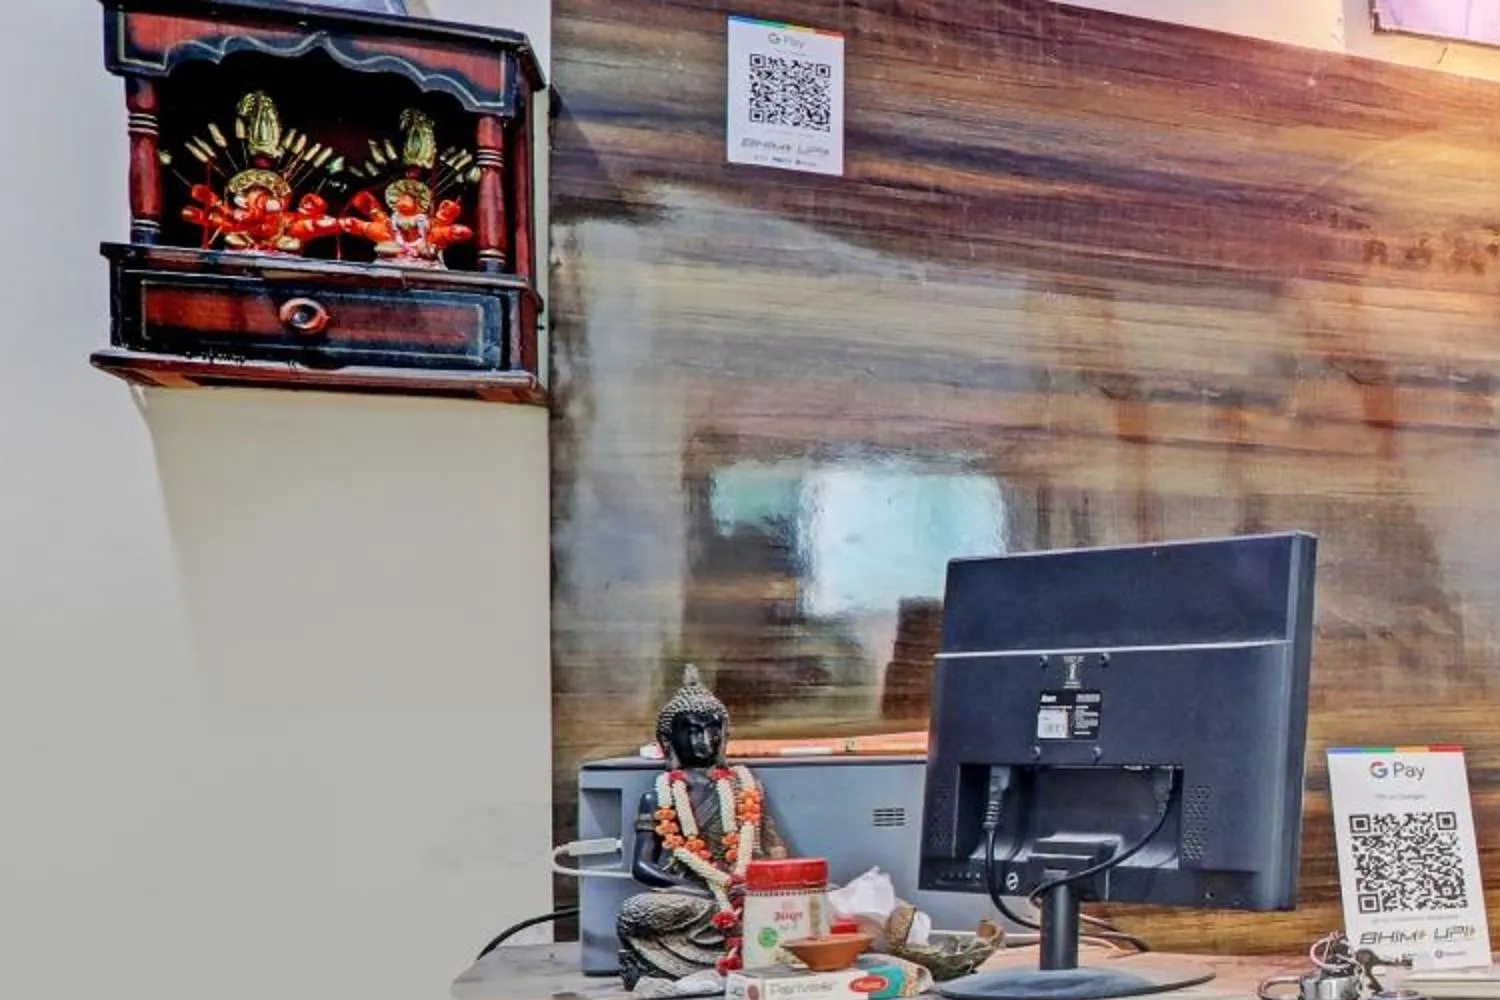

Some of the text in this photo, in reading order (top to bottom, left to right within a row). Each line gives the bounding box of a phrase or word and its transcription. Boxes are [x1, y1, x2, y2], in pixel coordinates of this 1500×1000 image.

[1369, 761, 1425, 782] G Pay
[1359, 929, 1418, 945] BHIM
